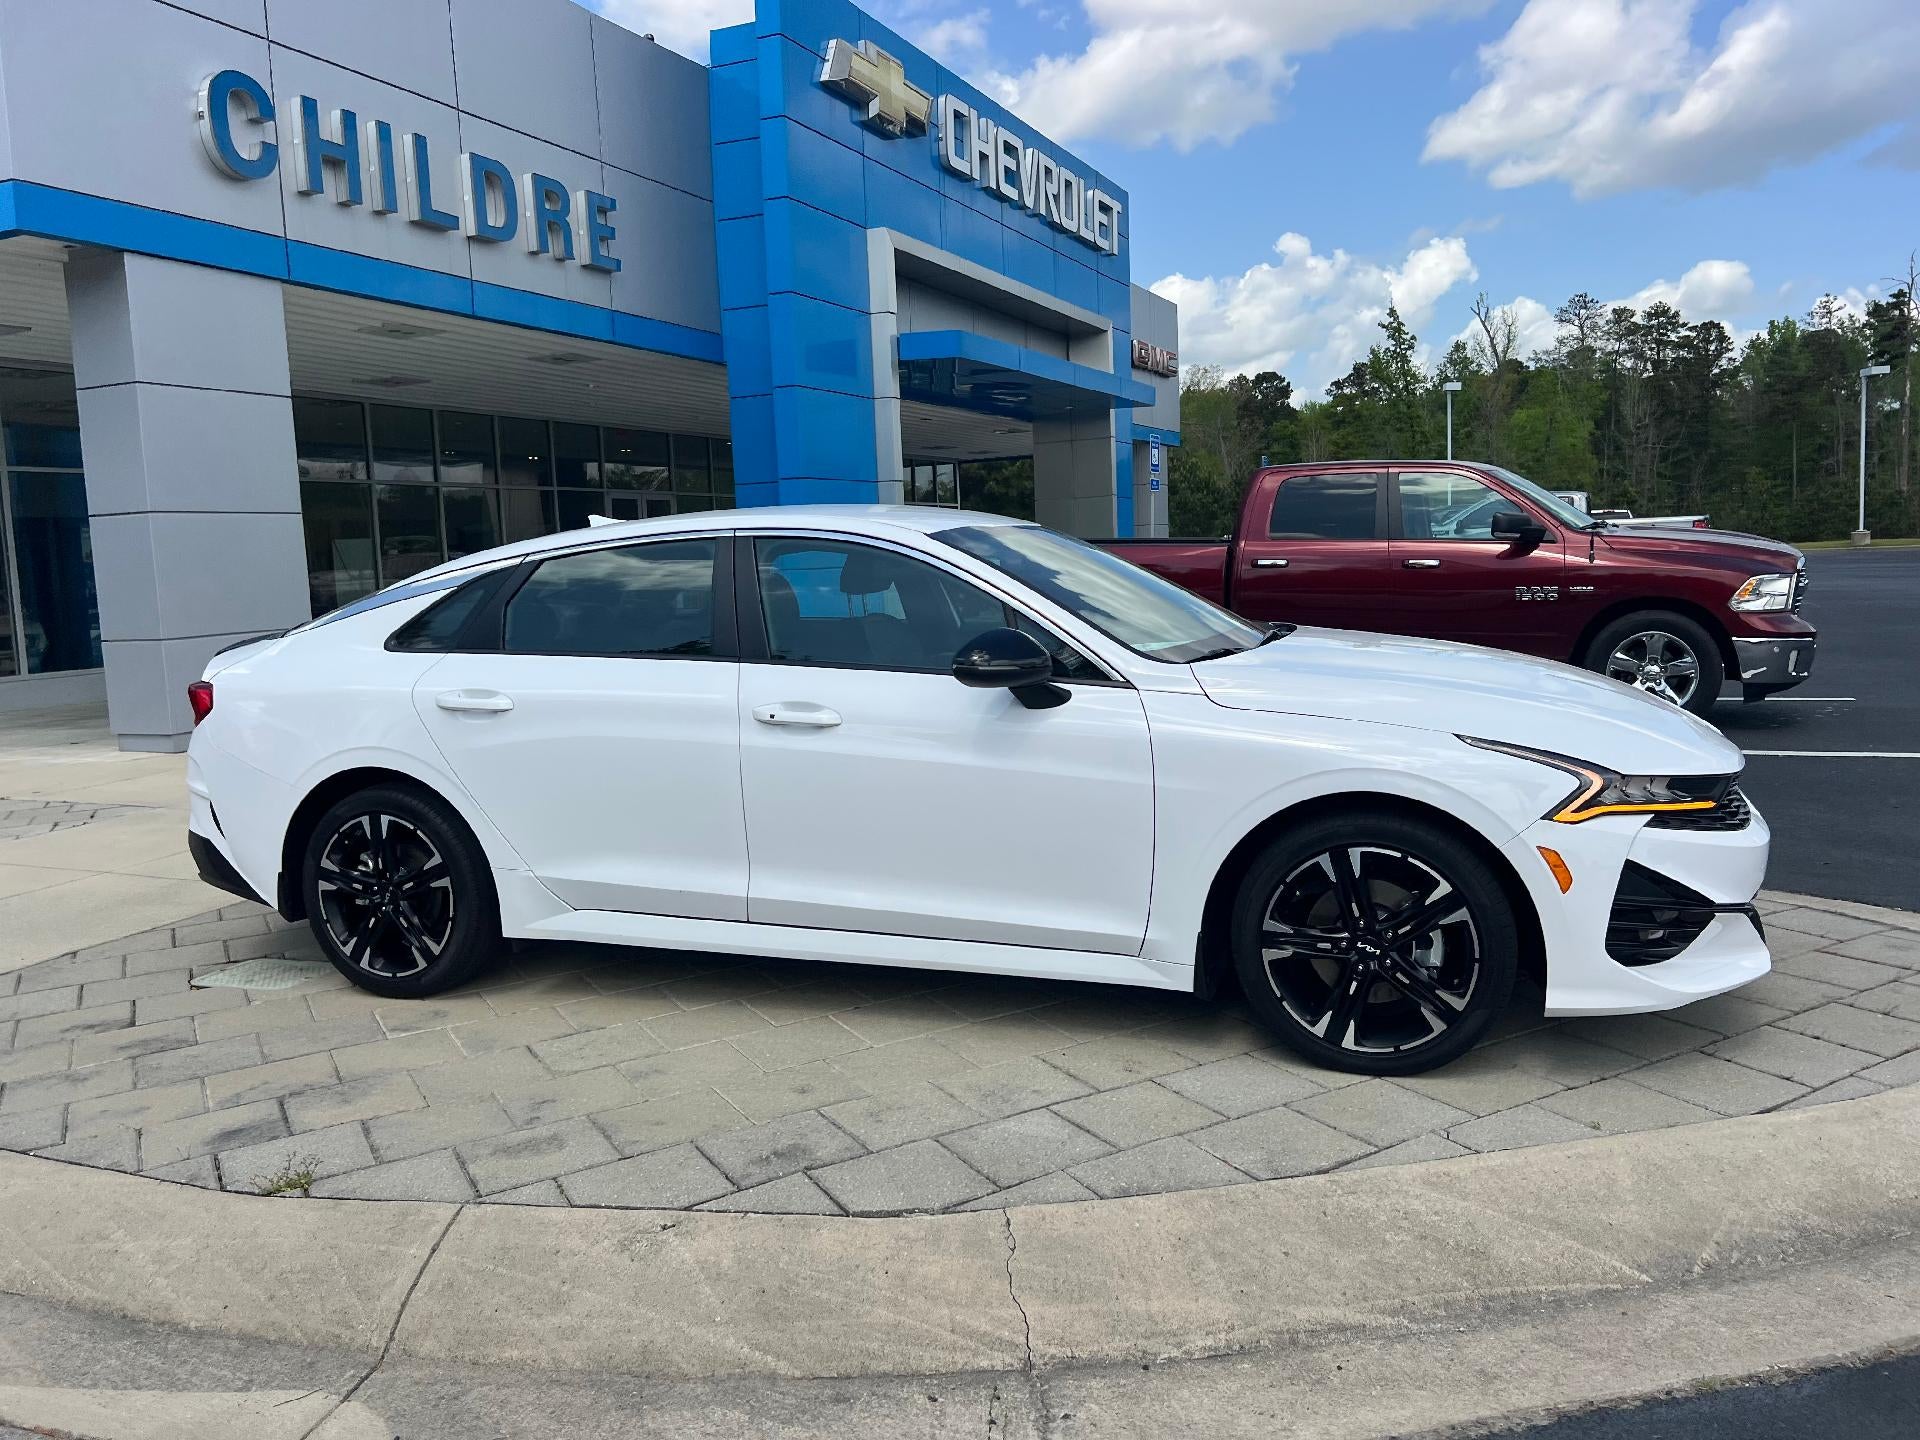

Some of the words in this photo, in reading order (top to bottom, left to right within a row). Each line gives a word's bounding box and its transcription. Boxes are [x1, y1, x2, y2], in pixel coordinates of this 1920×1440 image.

[199, 69, 621, 273] CHILDRE
[938, 93, 1122, 256] CHEVROLET
[1132, 339, 1178, 376] GMC
[1515, 593, 1559, 601] 1500
